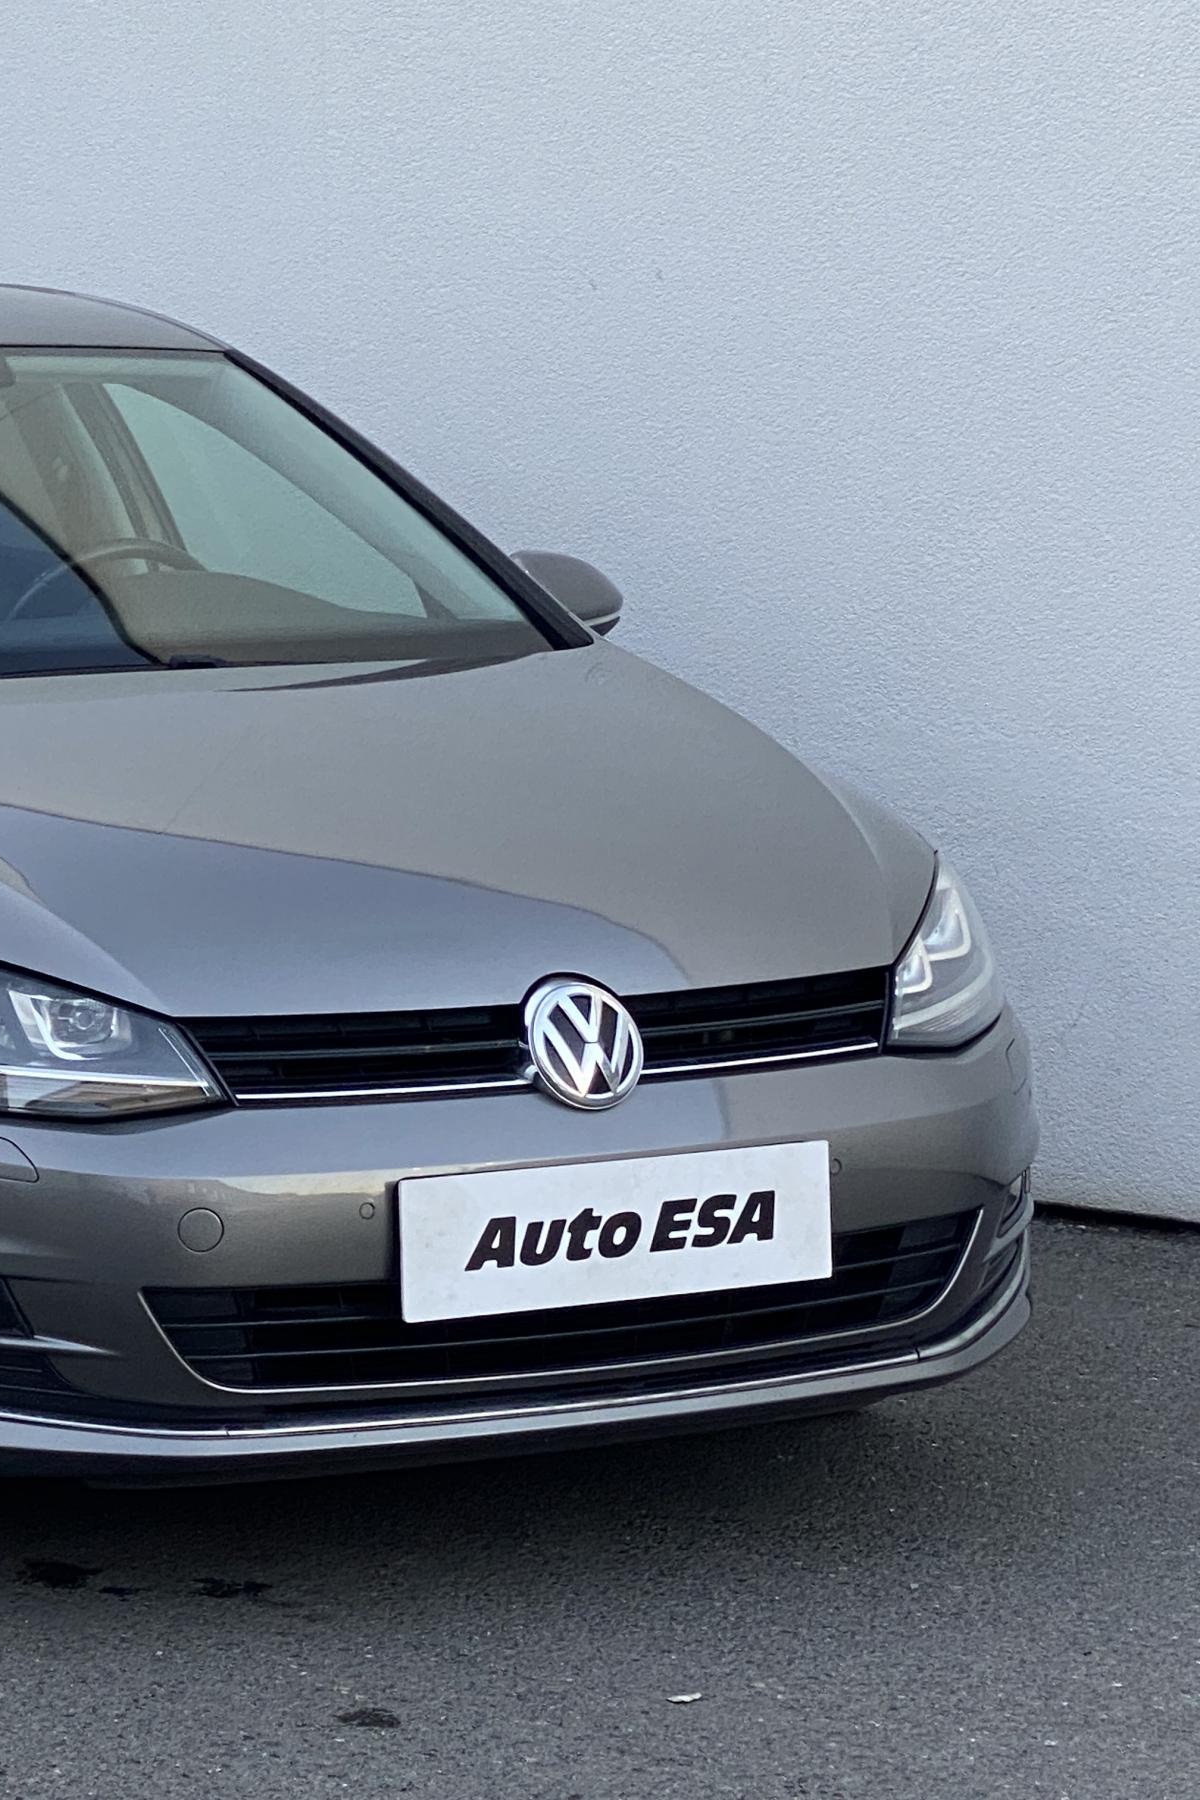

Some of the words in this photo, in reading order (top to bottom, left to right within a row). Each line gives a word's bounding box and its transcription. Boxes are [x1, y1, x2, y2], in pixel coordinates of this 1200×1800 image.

[537, 987, 636, 1102] VW
[464, 1207, 642, 1272] Auto
[649, 1190, 776, 1253] ESA
